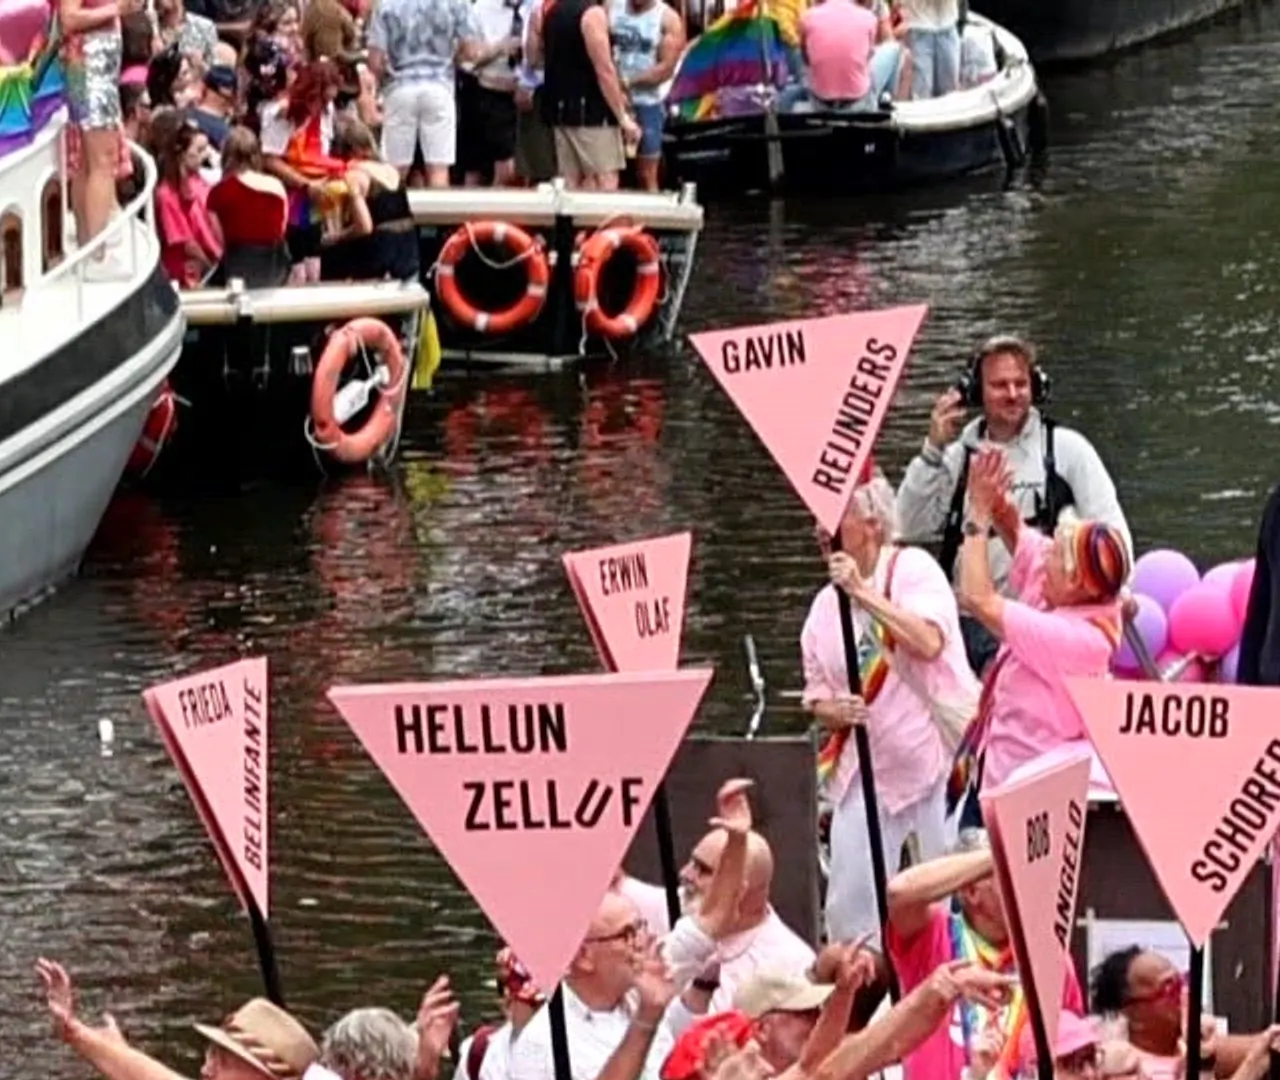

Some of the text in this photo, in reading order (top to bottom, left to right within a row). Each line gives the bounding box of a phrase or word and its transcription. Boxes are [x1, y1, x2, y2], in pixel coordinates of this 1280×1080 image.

[722, 329, 806, 375] GAVIN
[811, 338, 898, 495] REIJNDERS
[598, 553, 649, 597] ERWIN
[635, 596, 670, 638] OLAF
[178, 680, 233, 729] FRIEDA
[394, 703, 568, 754] HELLUN
[1119, 692, 1230, 738] JACOB
[243, 677, 262, 872] BELINFANTE
[462, 777, 643, 831] ZELLUF
[1026, 810, 1051, 863] BOB
[1053, 799, 1082, 950] ANGELO
